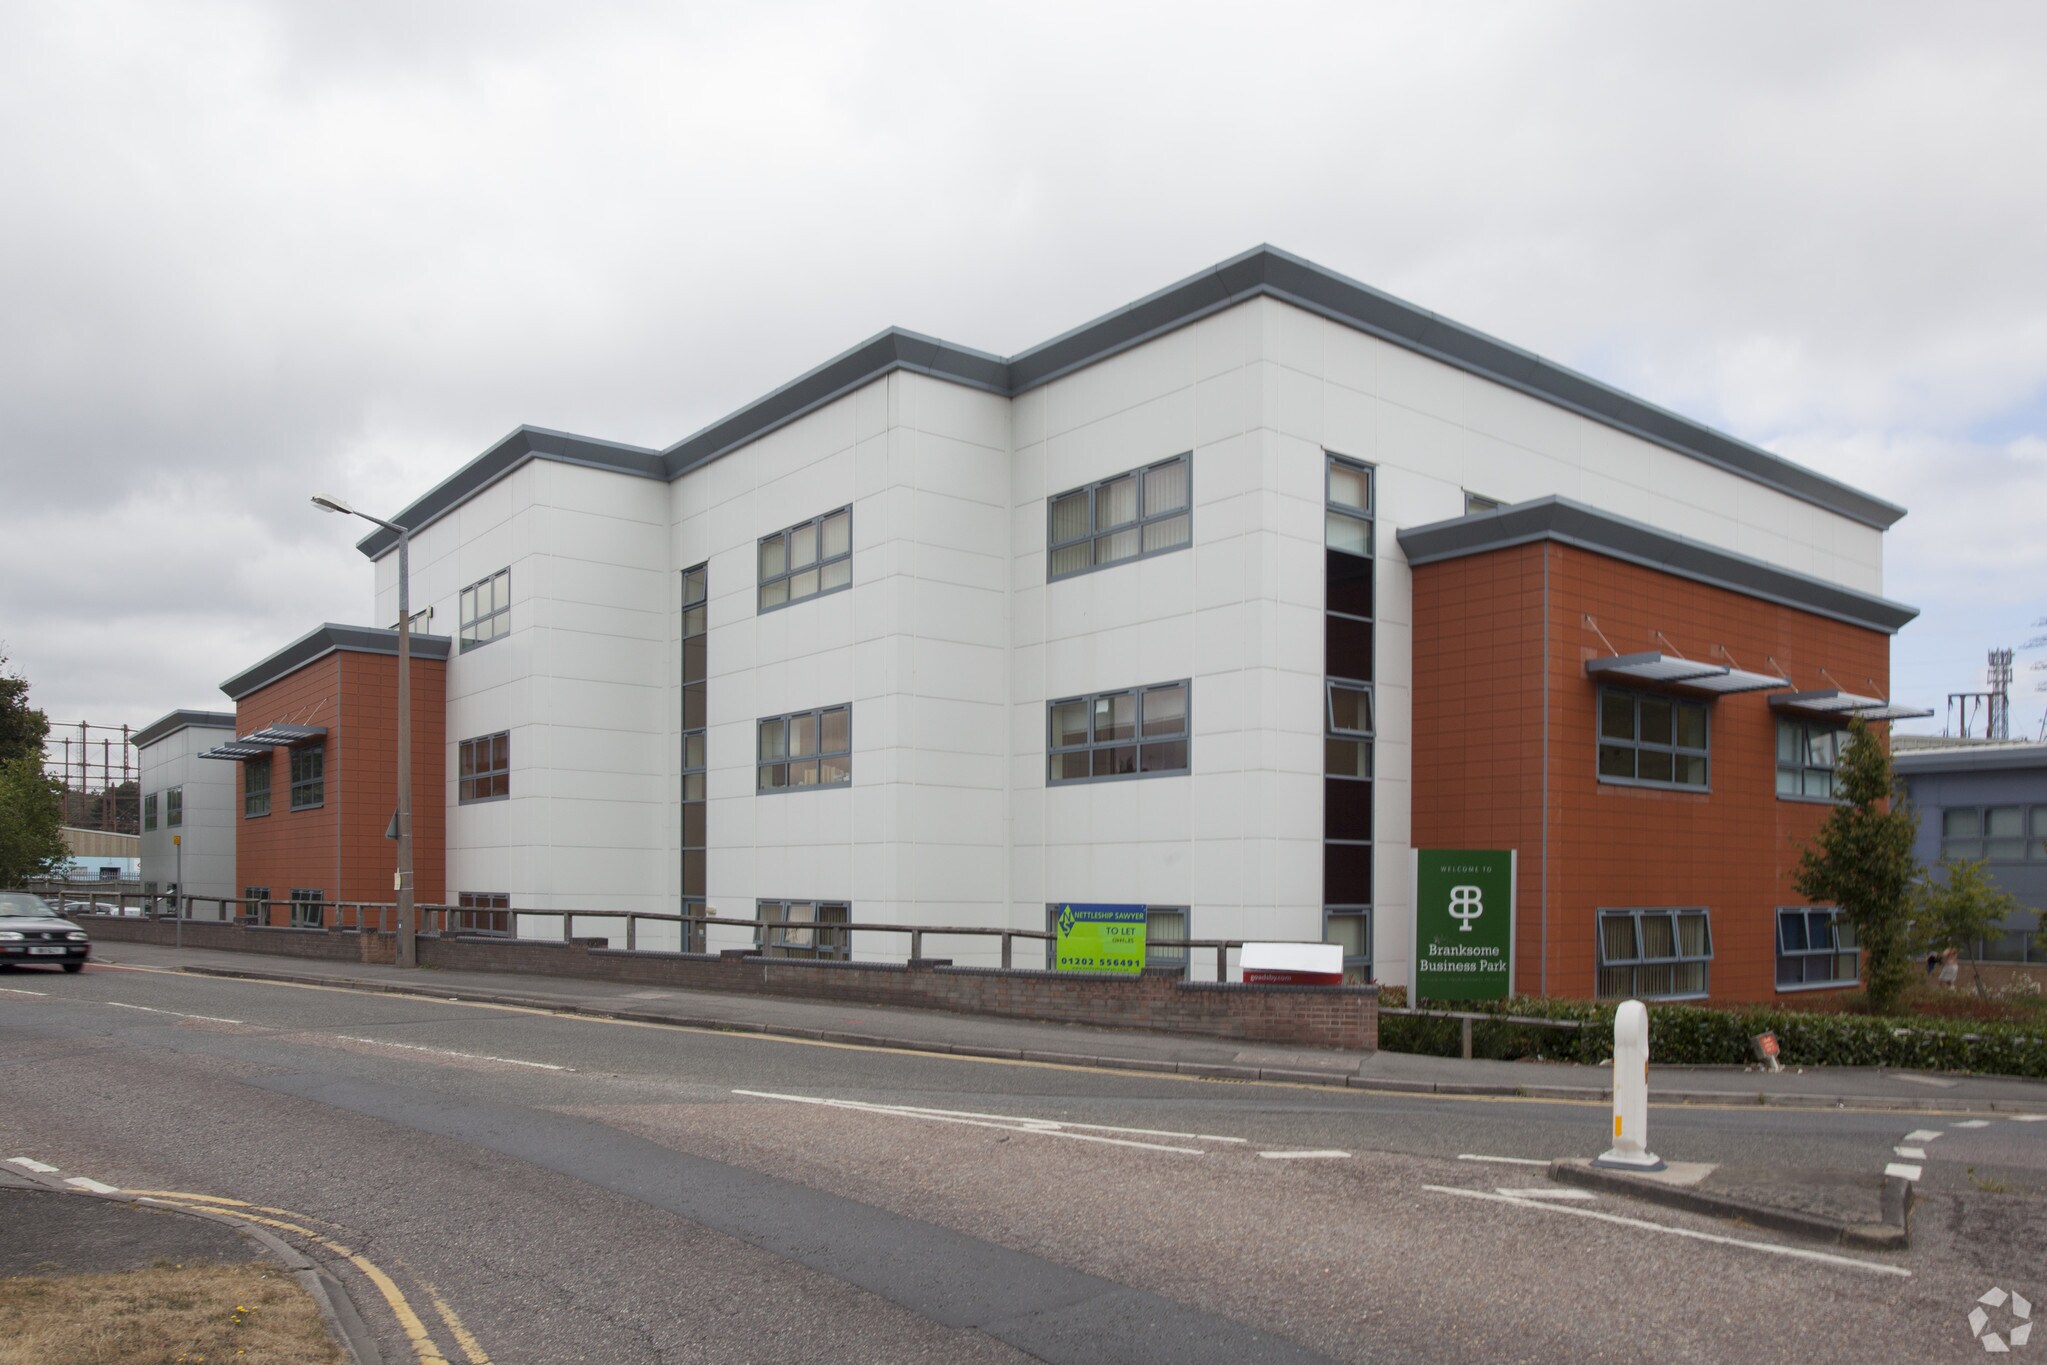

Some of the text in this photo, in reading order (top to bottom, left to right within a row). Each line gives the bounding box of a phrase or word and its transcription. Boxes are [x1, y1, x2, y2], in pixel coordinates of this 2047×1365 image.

[1440, 865, 1479, 873] WELCOME
[1074, 911, 1144, 920] NETTLESHIP SAWYER
[1106, 927, 1136, 935] TO LET
[1429, 944, 1500, 957] Branksome
[1061, 957, 1094, 965] 01202
[1420, 960, 1507, 972] Business Park
